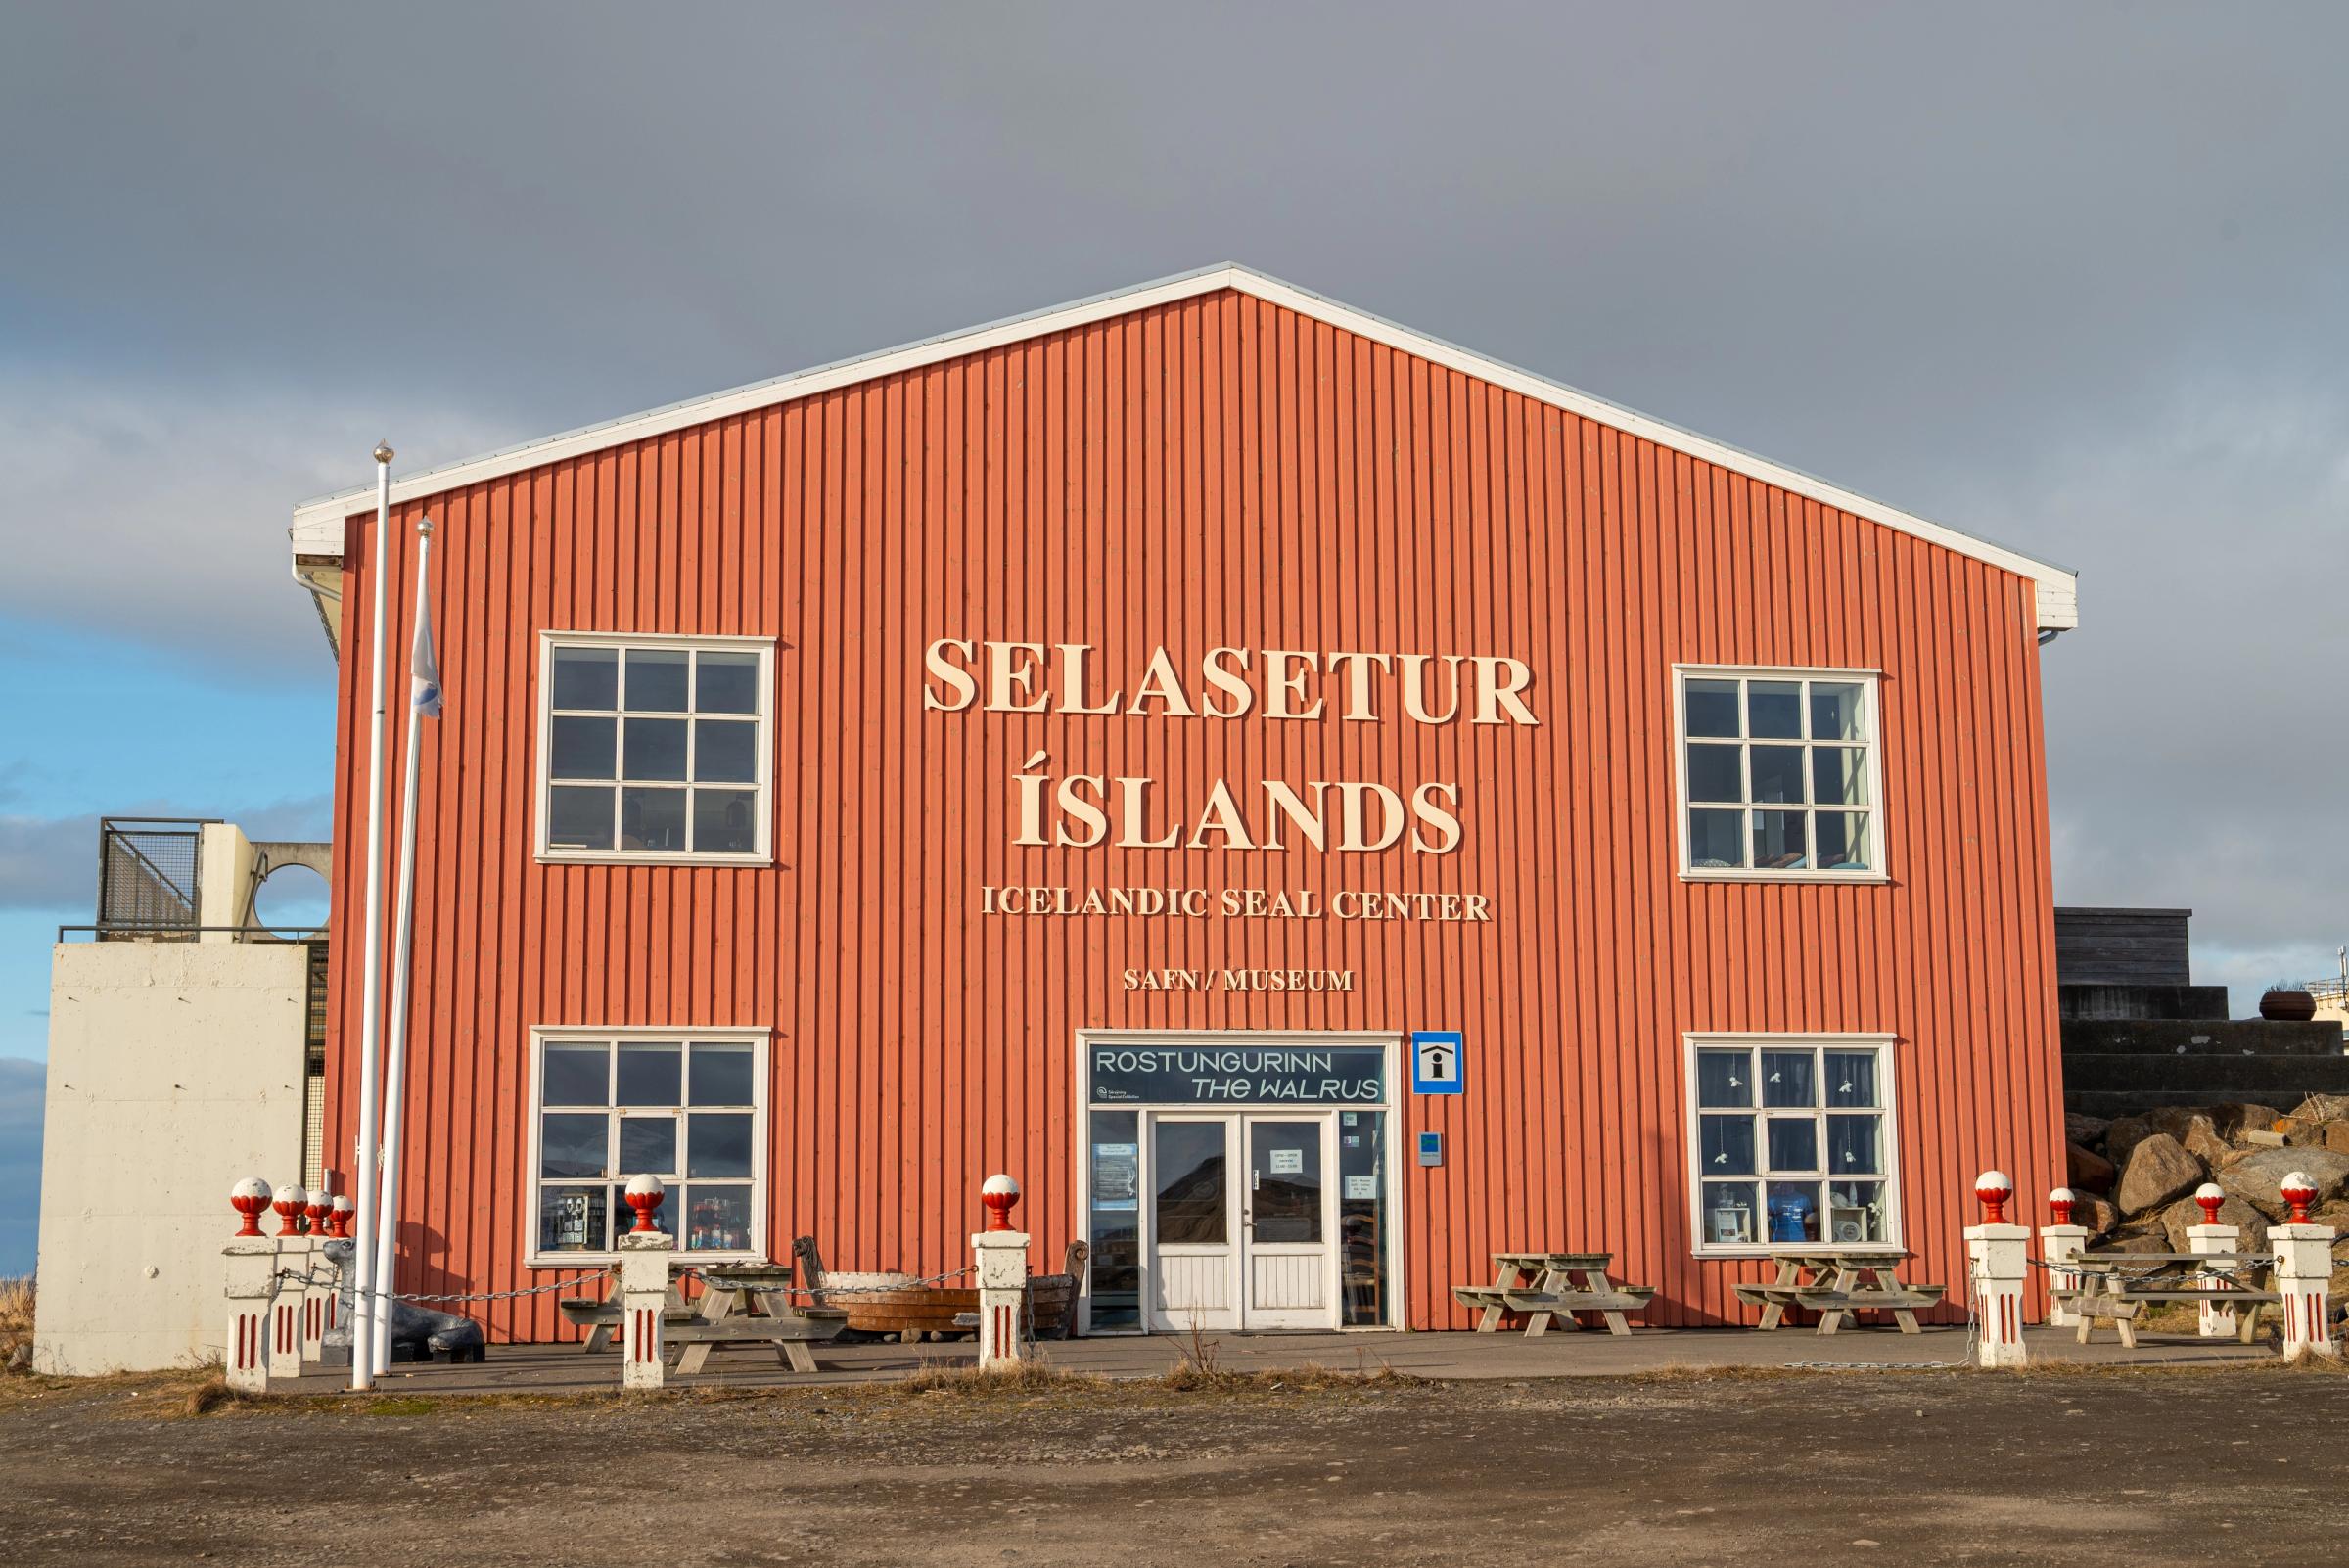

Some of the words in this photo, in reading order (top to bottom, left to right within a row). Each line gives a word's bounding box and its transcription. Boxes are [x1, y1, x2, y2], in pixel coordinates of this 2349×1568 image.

[924, 638, 1540, 725] SELASETUR
[1011, 750, 1460, 853] ÍSLANDS
[981, 886, 1207, 917] ICELANDIC
[1221, 888, 1321, 917] SEAL
[1332, 891, 1490, 921] CENTER
[1124, 969, 1198, 991] SAFN
[1222, 969, 1354, 991] MUSEUM
[1096, 1051, 1331, 1073] ROSTUNGURINN
[1259, 1079, 1380, 1100] WALRUS
